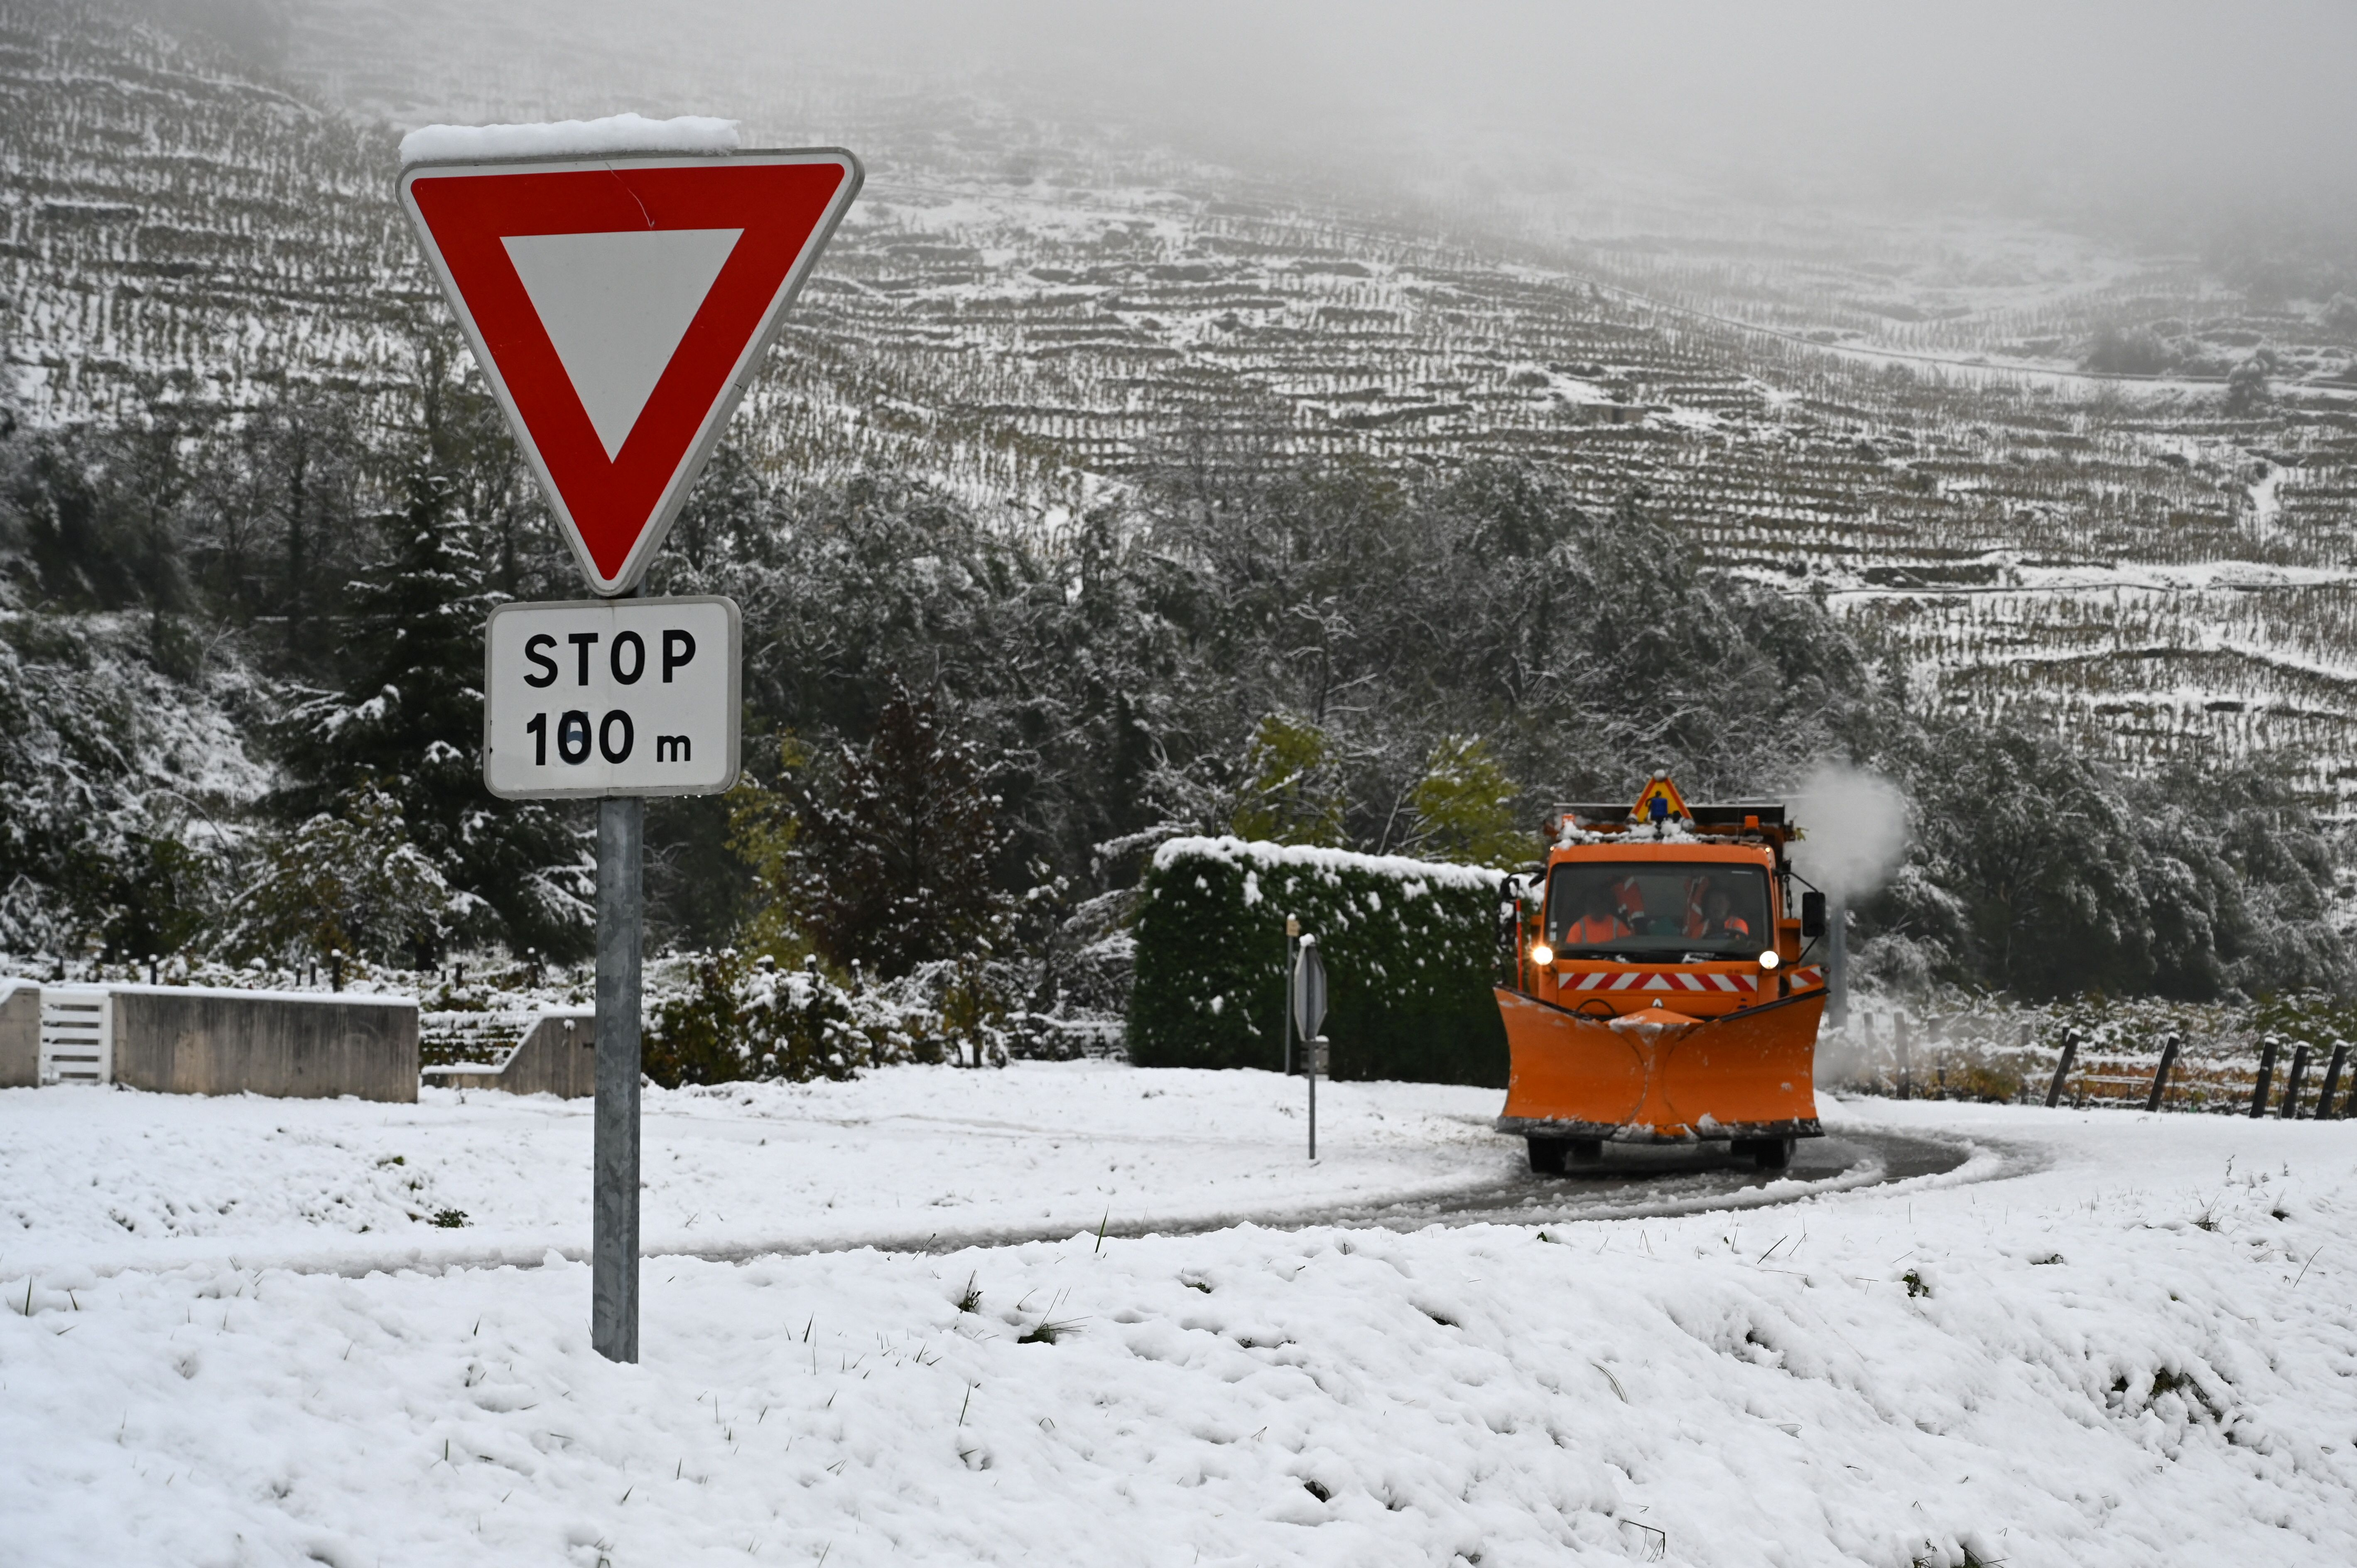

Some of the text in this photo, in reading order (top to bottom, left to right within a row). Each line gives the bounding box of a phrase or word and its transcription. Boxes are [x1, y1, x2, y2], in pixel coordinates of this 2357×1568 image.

[524, 629, 696, 688] STOP
[527, 710, 691, 765] 100 m
